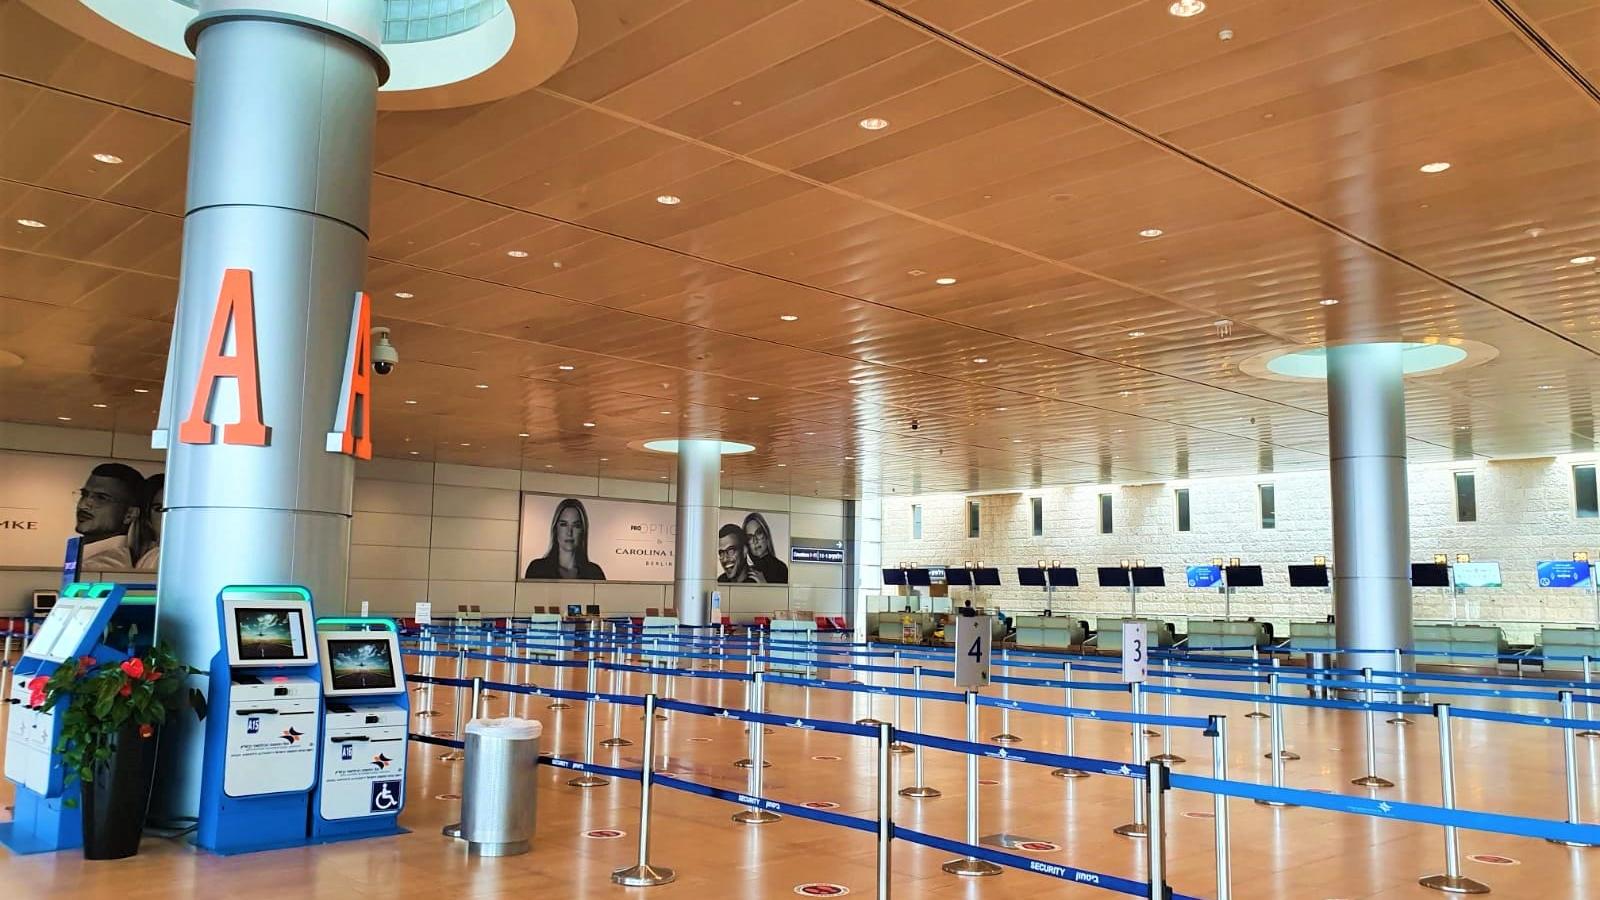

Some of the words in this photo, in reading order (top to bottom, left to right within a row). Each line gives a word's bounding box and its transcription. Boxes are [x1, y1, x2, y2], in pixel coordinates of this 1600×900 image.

[178, 268, 270, 446] A
[335, 292, 372, 460] A
[615, 548, 667, 557] CAROLINA
[968, 636, 982, 663] 4
[1133, 639, 1141, 662] 3
[248, 719, 259, 731] A15
[342, 746, 352, 757] A16
[1030, 861, 1066, 877] SECURITY
[1075, 871, 1099, 883] ביטחון
